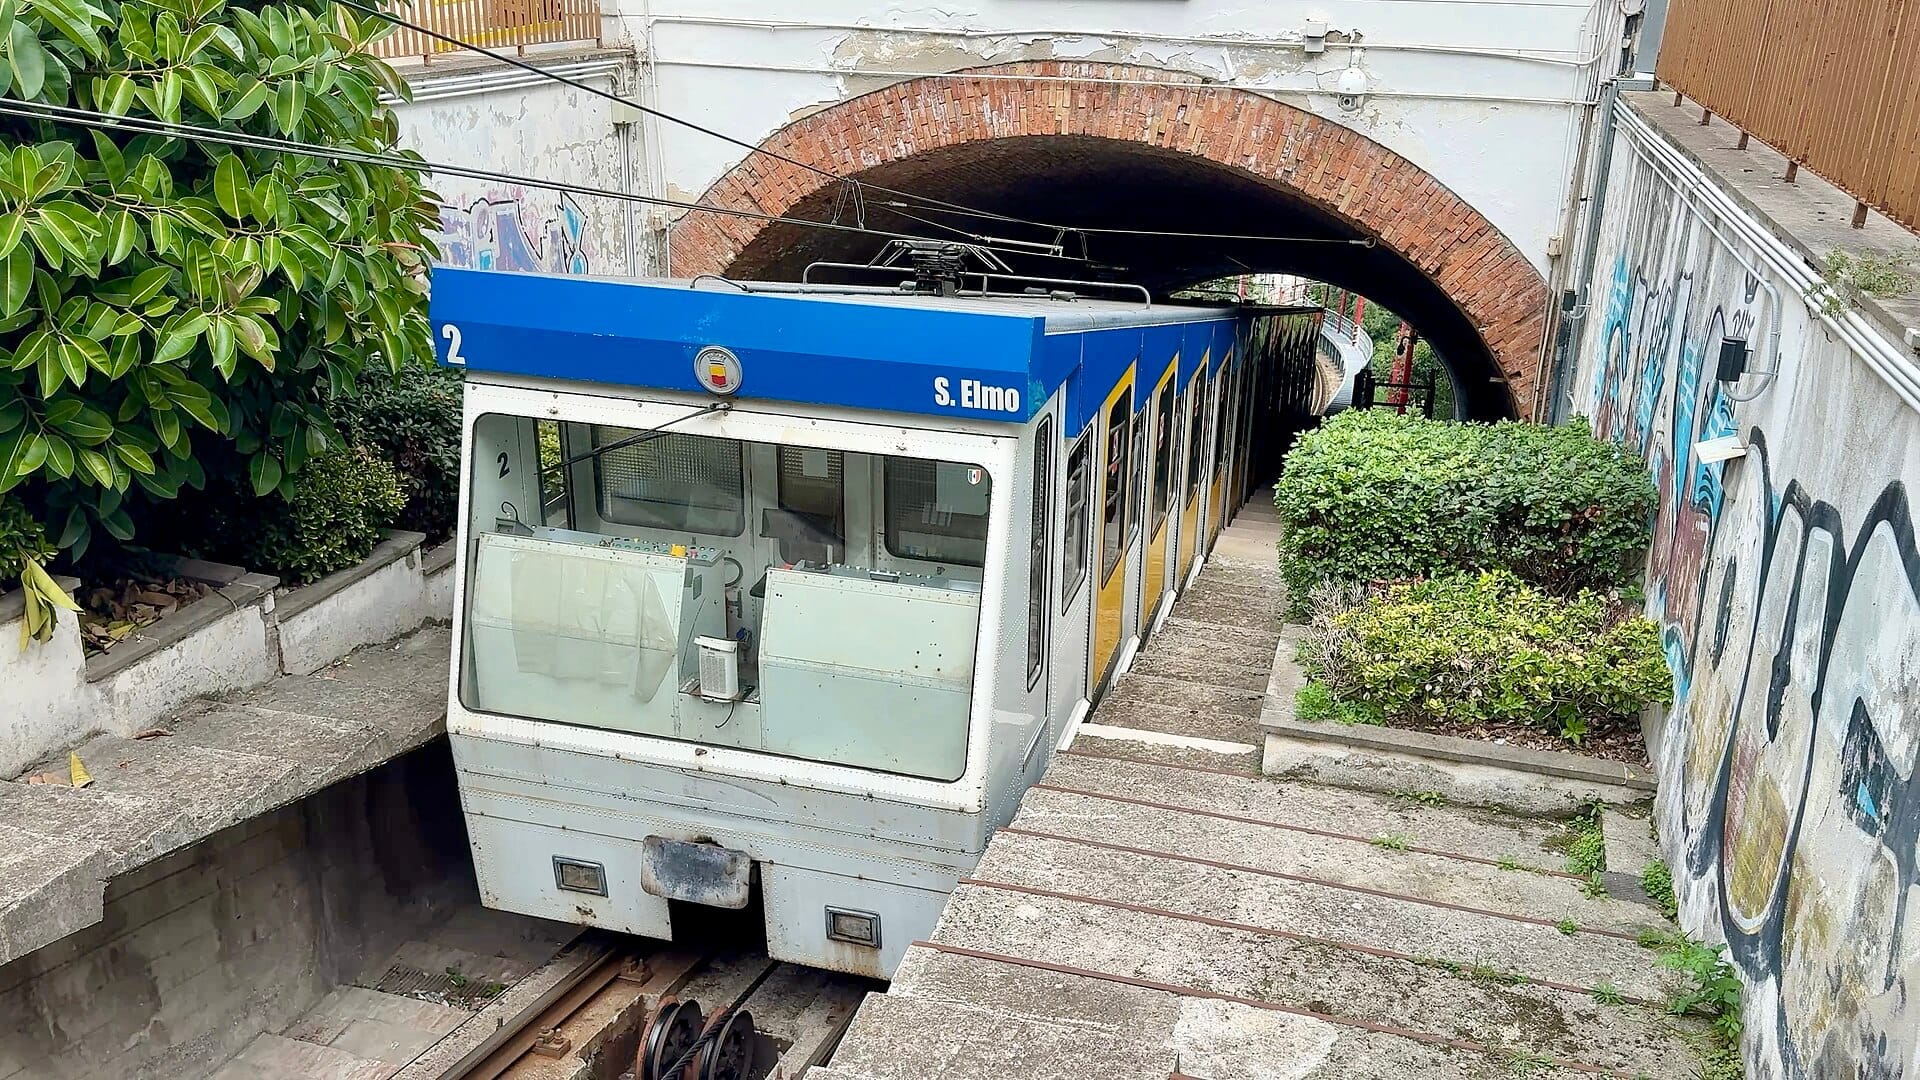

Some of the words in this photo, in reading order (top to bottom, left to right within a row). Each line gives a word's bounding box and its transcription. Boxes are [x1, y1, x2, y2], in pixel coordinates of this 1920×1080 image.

[442, 324, 465, 364] 2
[934, 376, 956, 406] S.
[960, 379, 1020, 412] Elmo
[497, 451, 510, 479] 2
